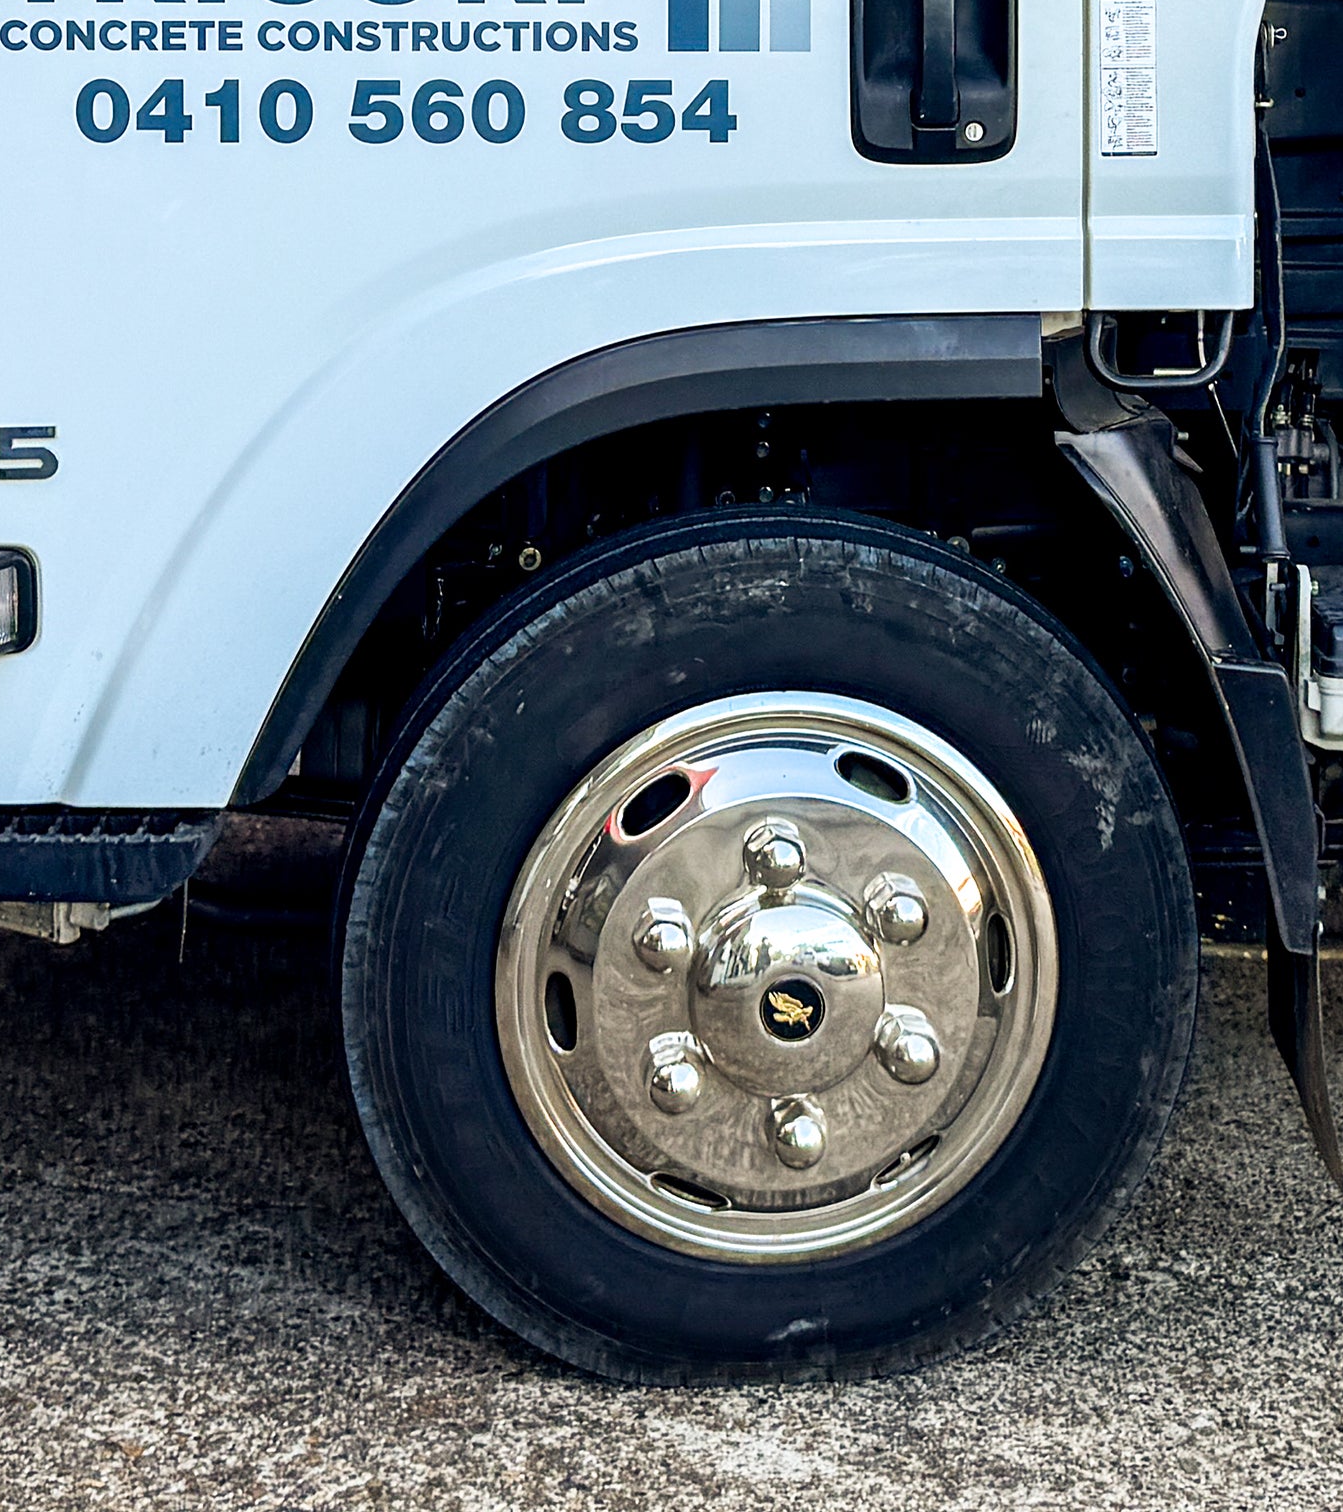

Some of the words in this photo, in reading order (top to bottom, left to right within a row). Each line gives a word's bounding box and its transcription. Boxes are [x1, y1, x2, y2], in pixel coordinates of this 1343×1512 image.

[0, 19, 244, 53] CONCRETE
[256, 19, 640, 53] CONSTRUCTIONS
[74, 78, 314, 145] 0410
[347, 78, 526, 145] 560
[560, 78, 738, 145] 854
